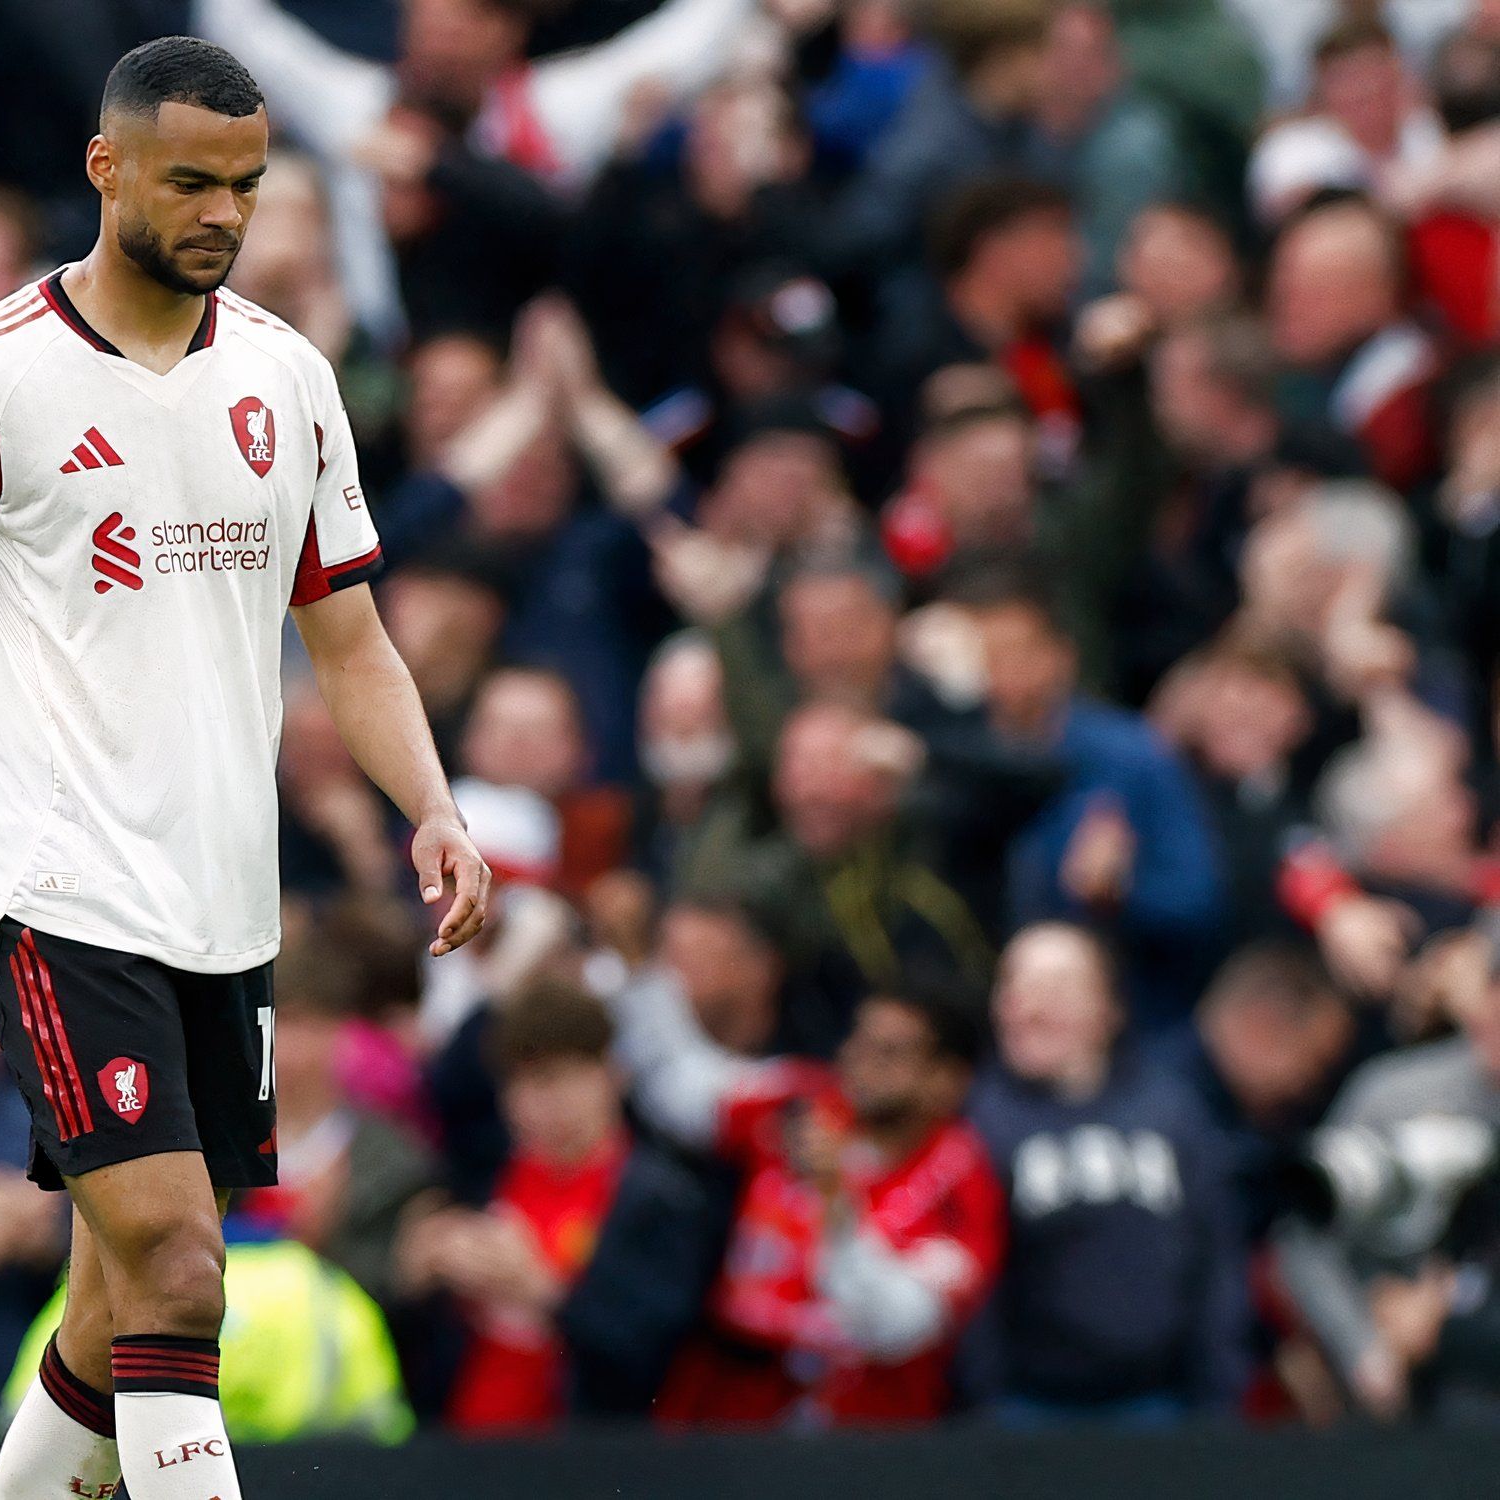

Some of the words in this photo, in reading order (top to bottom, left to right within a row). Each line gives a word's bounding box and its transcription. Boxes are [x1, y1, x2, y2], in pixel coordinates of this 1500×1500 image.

[249, 448, 272, 462] LFC
[151, 517, 267, 547] standard
[155, 545, 270, 574] chartered
[257, 1006, 276, 1101] 1
[154, 1439, 225, 1469] LFC
